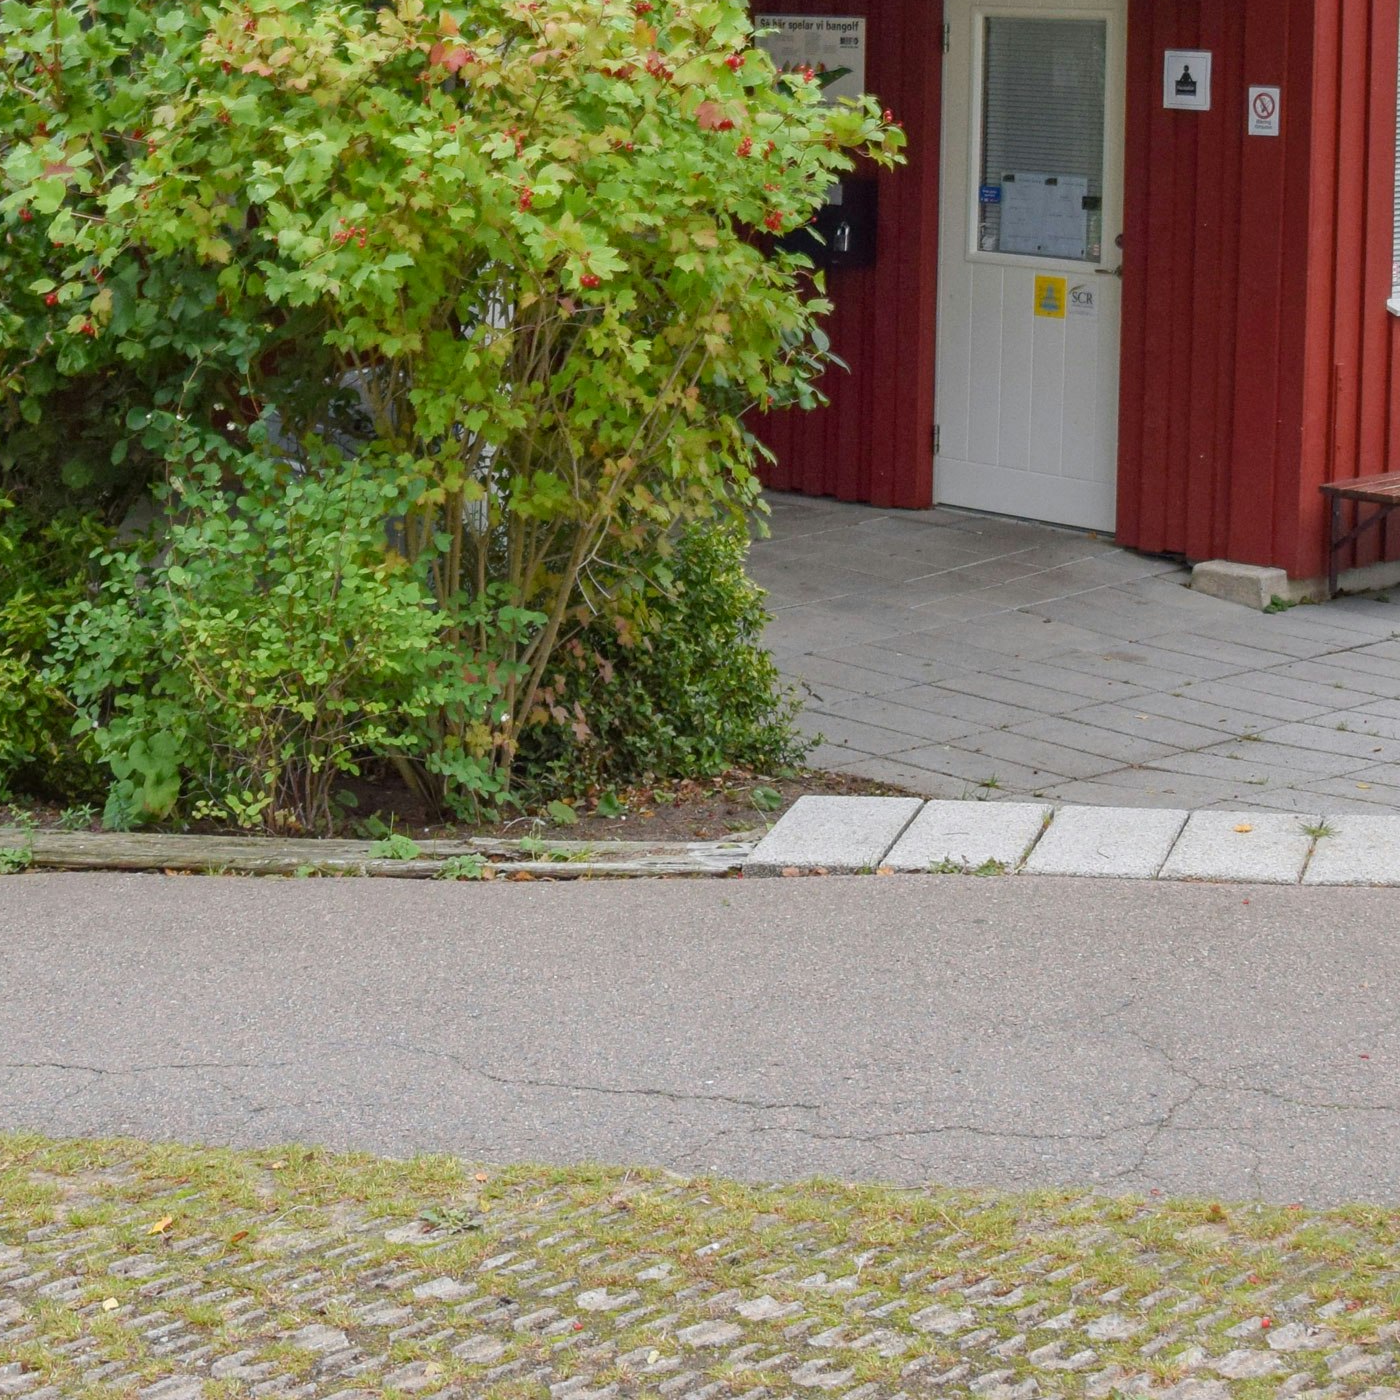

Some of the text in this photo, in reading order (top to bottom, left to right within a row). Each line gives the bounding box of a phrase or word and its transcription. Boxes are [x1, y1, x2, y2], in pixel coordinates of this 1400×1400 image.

[788, 20, 814, 32] spelar
[816, 21, 824, 30] vi
[826, 21, 859, 33] bangolf
[1072, 291, 1093, 304] SCR
